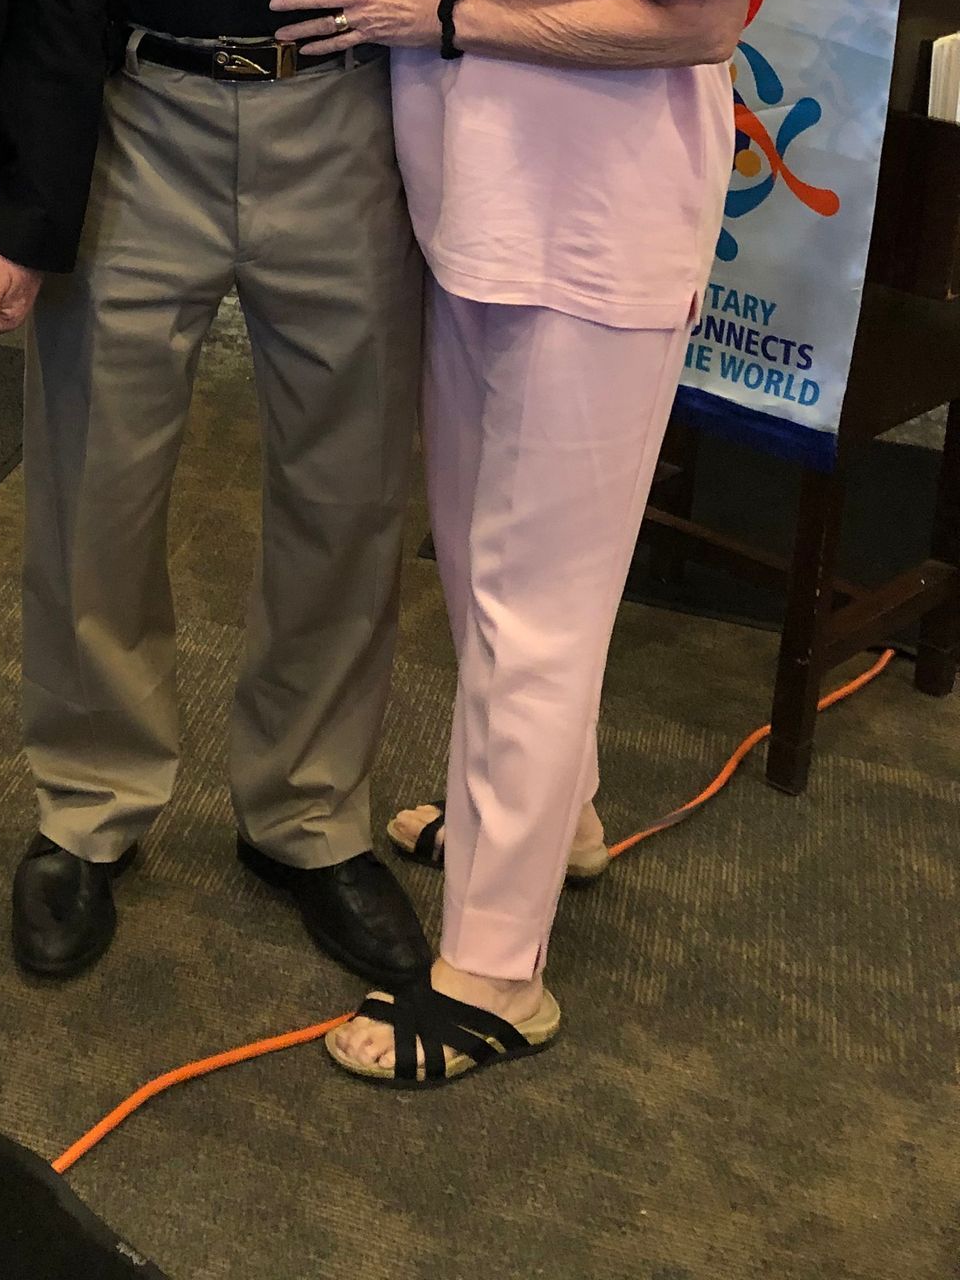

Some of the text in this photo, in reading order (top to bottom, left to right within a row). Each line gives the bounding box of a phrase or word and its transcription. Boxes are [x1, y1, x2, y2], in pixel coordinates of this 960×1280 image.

[709, 283, 777, 326] TARY
[691, 314, 814, 370] NNECTS
[720, 352, 820, 406] WORLD
